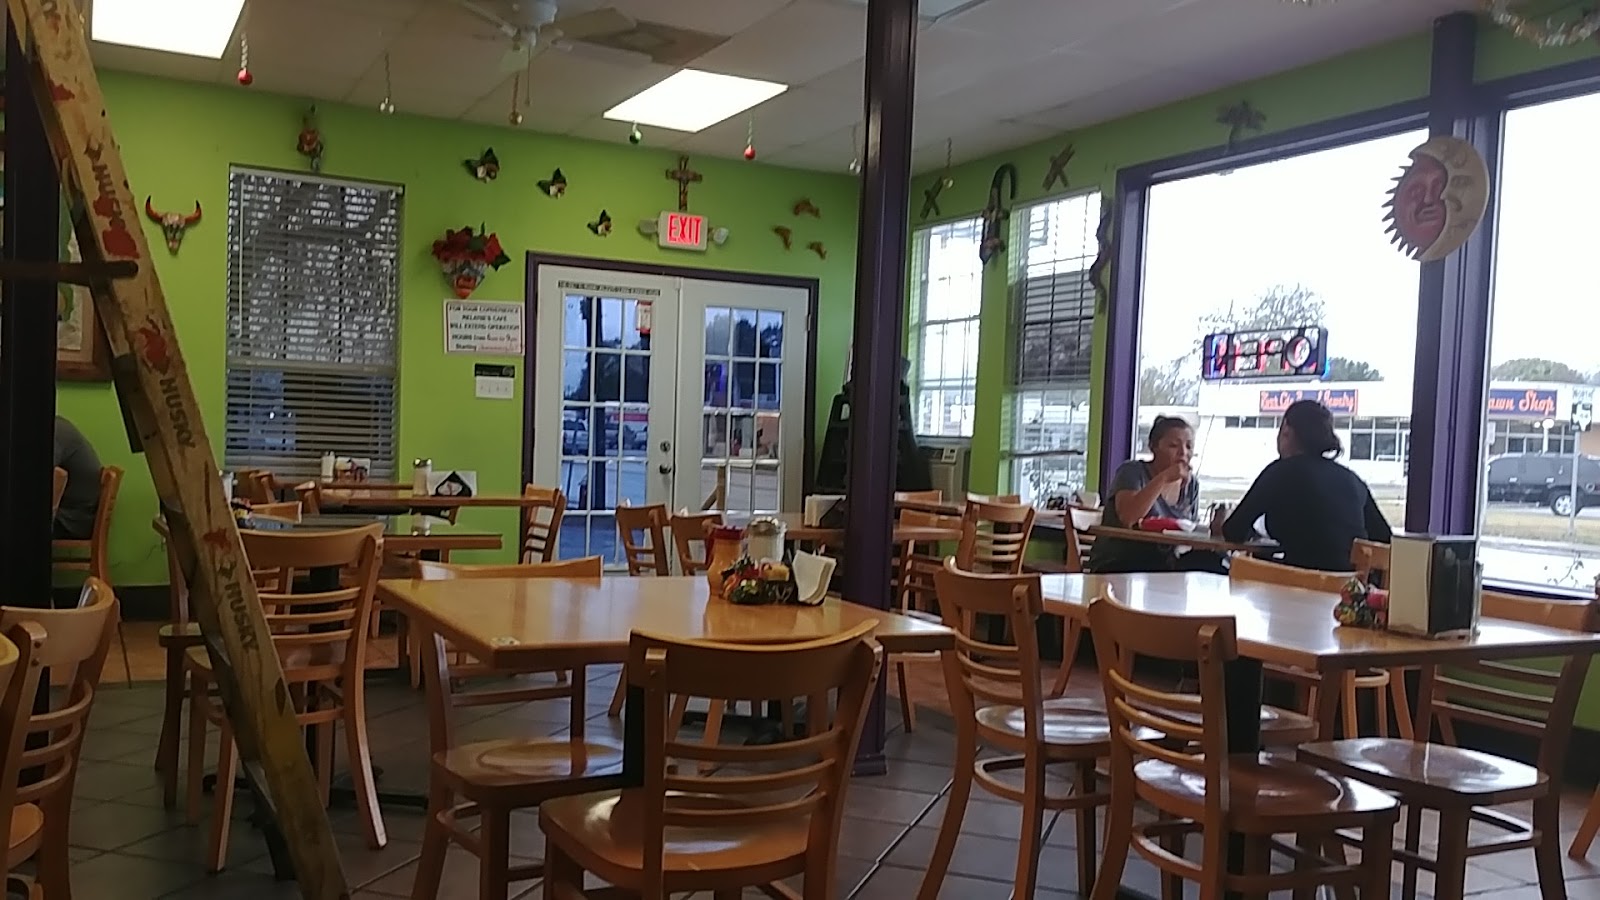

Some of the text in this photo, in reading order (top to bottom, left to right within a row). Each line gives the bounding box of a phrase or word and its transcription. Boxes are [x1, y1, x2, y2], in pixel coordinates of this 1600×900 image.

[668, 213, 702, 245] EXIT
[159, 377, 197, 449] HUSKY
[1488, 397, 1515, 411] awn
[1518, 389, 1555, 416] Shop
